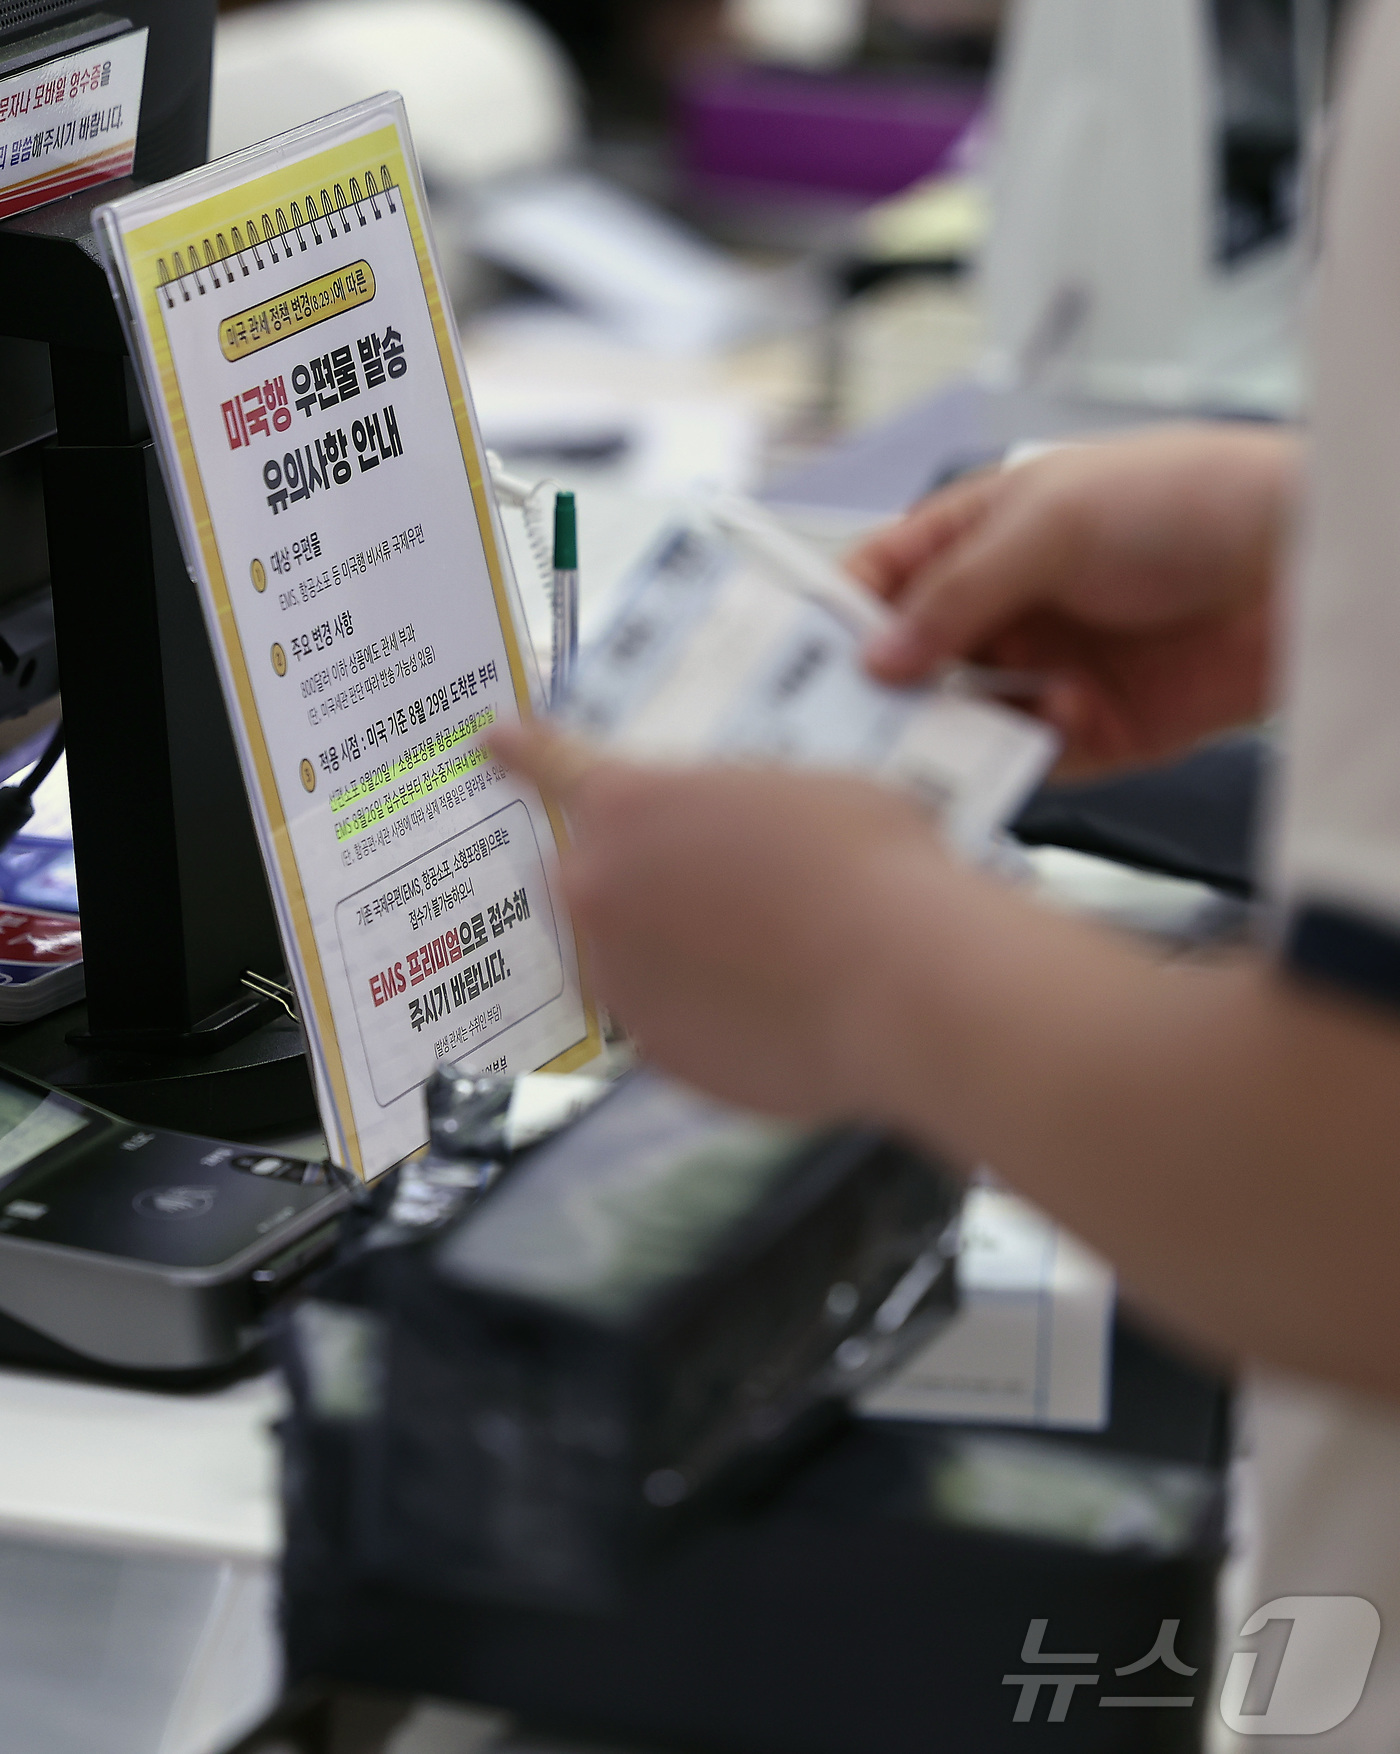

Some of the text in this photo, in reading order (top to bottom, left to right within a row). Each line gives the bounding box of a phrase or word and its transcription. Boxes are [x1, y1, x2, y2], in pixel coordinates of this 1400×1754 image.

[33, 76, 67, 110] 모바일
[70, 61, 112, 98] 영수증을
[10, 120, 76, 167] 말씀해주시기
[78, 104, 123, 141] 바랍니다.
[226, 268, 368, 348] 미국 관세 정책 변경(8.29.)에 따른
[220, 325, 408, 451] 미국행 우편물 발송
[263, 404, 404, 515] 유의사항 안내
[269, 531, 322, 575] 대상 우편물
[299, 571, 332, 602] 항공소포
[331, 564, 342, 586] 등
[341, 551, 367, 579] 미국행
[365, 540, 392, 567] 비서류
[391, 523, 425, 554] 국제우편
[290, 609, 354, 662] 주요 변경 사항
[331, 658, 349, 682] 이하
[349, 642, 382, 675] 상품에도
[380, 631, 400, 658] 관세
[398, 622, 417, 648] 부과
[318, 745, 340, 774] 적용
[340, 733, 361, 763] 시점
[365, 719, 389, 748] 미국
[387, 708, 409, 737] 기준
[408, 698, 427, 726] 8월
[425, 685, 450, 717] 29일
[449, 671, 478, 703] 도착분
[477, 659, 499, 689] 부터
[320, 690, 349, 718] 미국세관
[348, 682, 365, 704] 판단
[364, 673, 381, 694] 따라
[379, 666, 396, 688] 반송
[394, 653, 419, 678] 가능성
[417, 644, 436, 669] 있음)
[334, 816, 352, 840] EMS
[352, 797, 385, 829] 8월26일
[383, 775, 424, 814] 접수분부터
[421, 753, 470, 792] 접수중지(국내
[359, 761, 392, 792] 8월20일
[391, 814, 413, 838] 사정에
[410, 805, 427, 827] 따라
[425, 799, 441, 822] 실제
[439, 784, 467, 811] 적용일은
[465, 773, 487, 798] 달라질
[485, 770, 493, 786] 수
[356, 827, 510, 926] 기존 국제우편(EMS, 항공소포, 소형포장물)으로는
[408, 877, 475, 931] 접수가 불가능하오니
[368, 887, 531, 1008] EMS 프리미엄으로 접수해
[408, 949, 511, 1033] 주시기 바랍니다.
[434, 1003, 502, 1060] (발생 관세는 수취인 부담)
